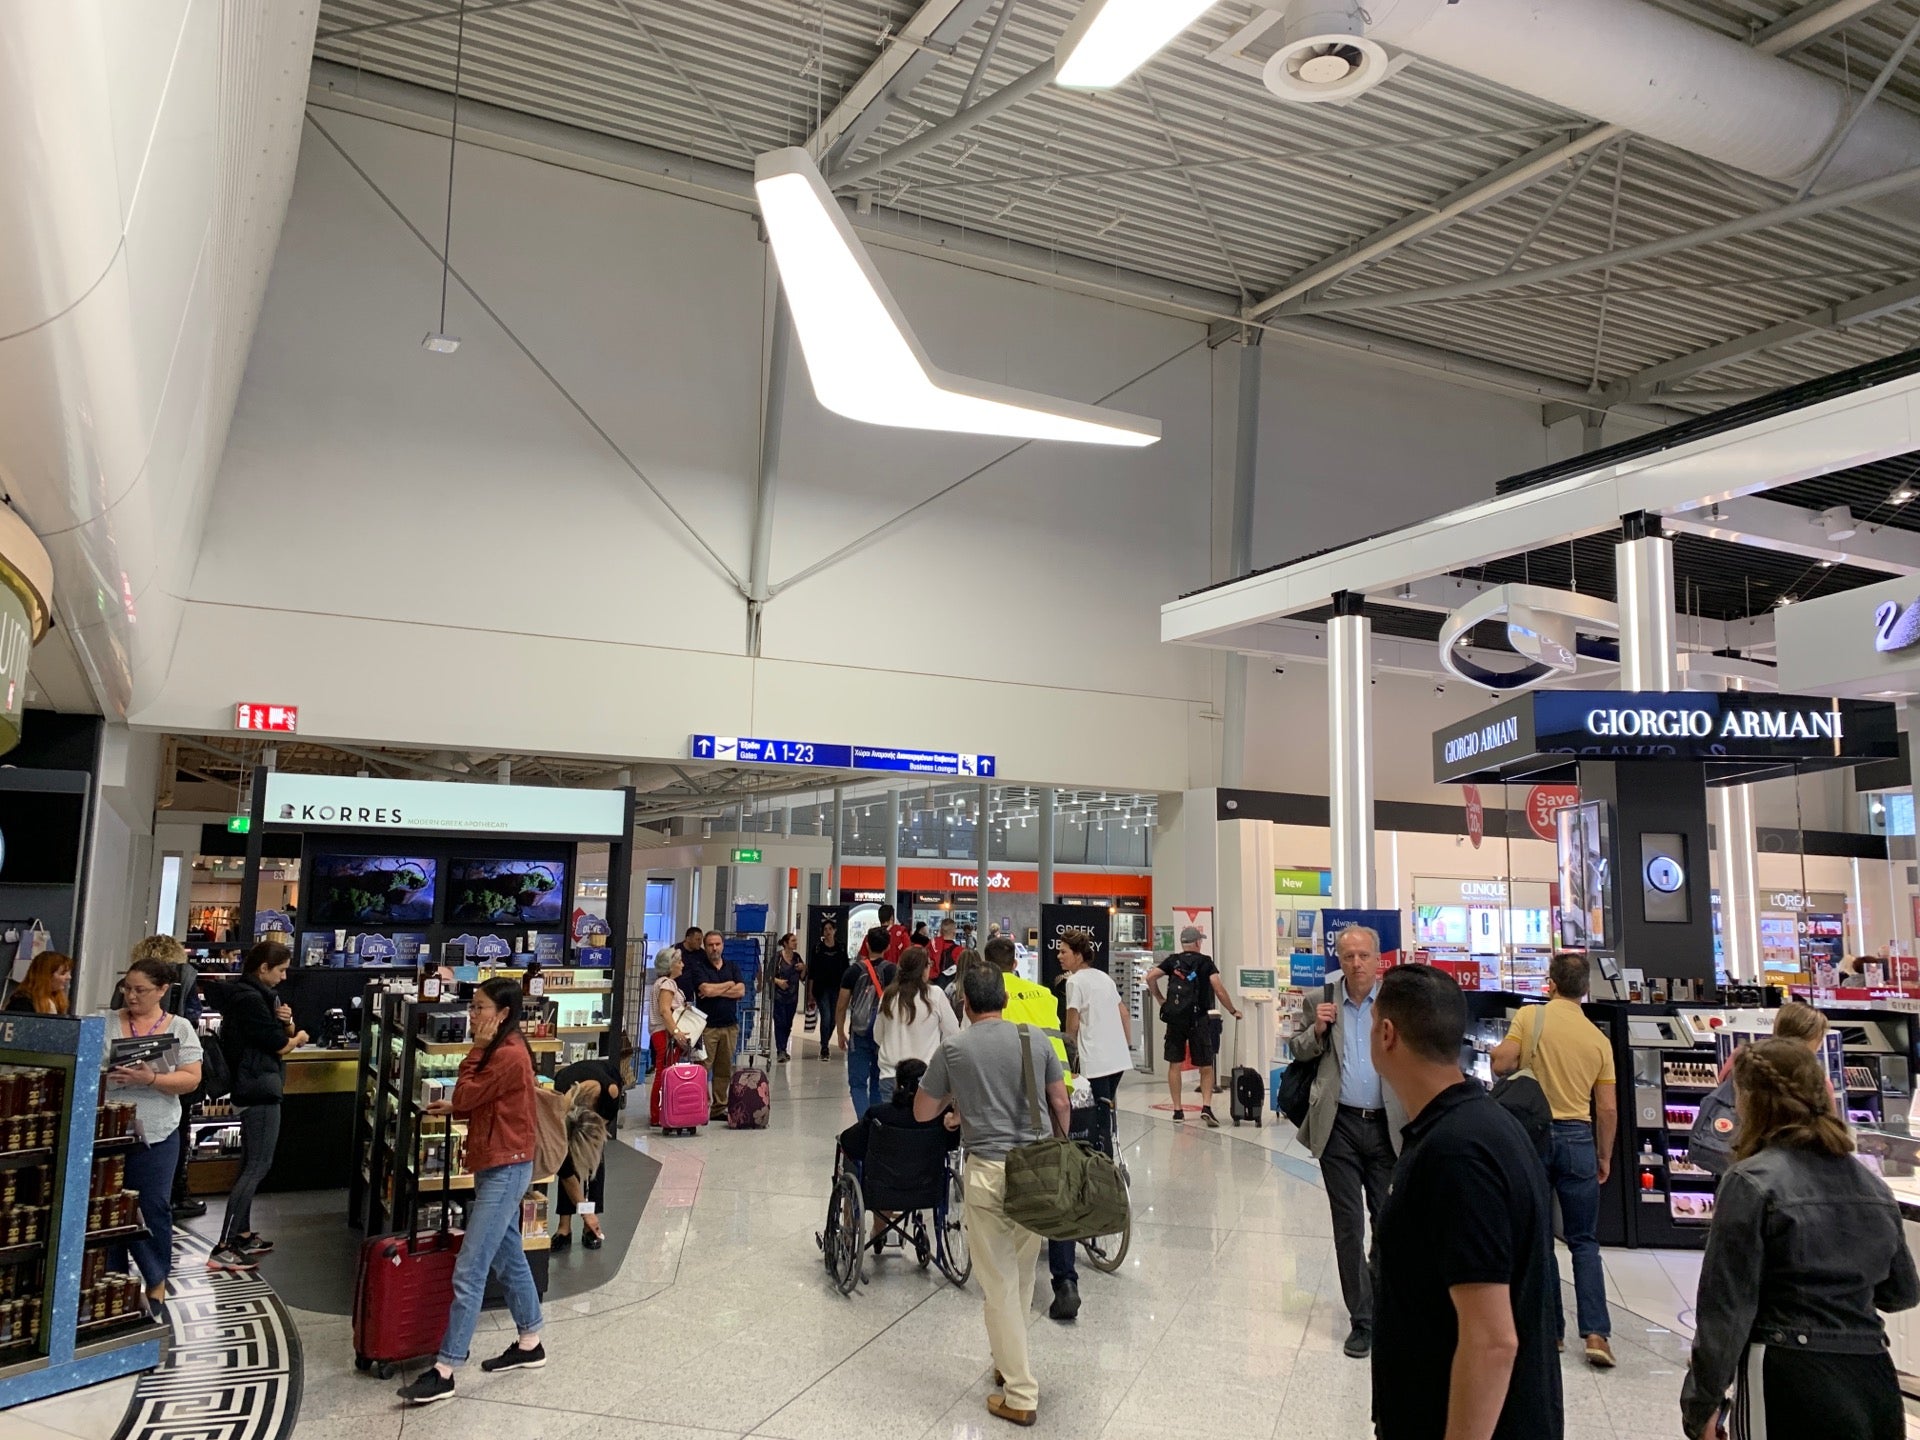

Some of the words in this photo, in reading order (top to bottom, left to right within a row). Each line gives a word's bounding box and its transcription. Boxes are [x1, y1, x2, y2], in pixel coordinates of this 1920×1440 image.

[1587, 709, 1713, 737] GIORGIO
[1720, 710, 1844, 738] ARMANI
[1445, 732, 1479, 763] GIORGIO
[1480, 716, 1518, 752] ARMANI
[740, 751, 757, 759] Gates
[763, 742, 776, 760] A
[782, 744, 814, 762] 1-23
[909, 763, 933, 771] Business
[934, 765, 957, 773] Lounges
[1536, 792, 1575, 807] Save
[302, 805, 402, 823] KORRES
[1282, 878, 1303, 888] New
[1461, 883, 1507, 896] CLINIQUE
[261, 922, 283, 931] OLIVE
[1332, 919, 1358, 928] Always
[1056, 924, 1095, 936] GREEK
[368, 944, 387, 954] OLIVE
[484, 945, 502, 954] OLIVE
[1457, 972, 1471, 986] 19
